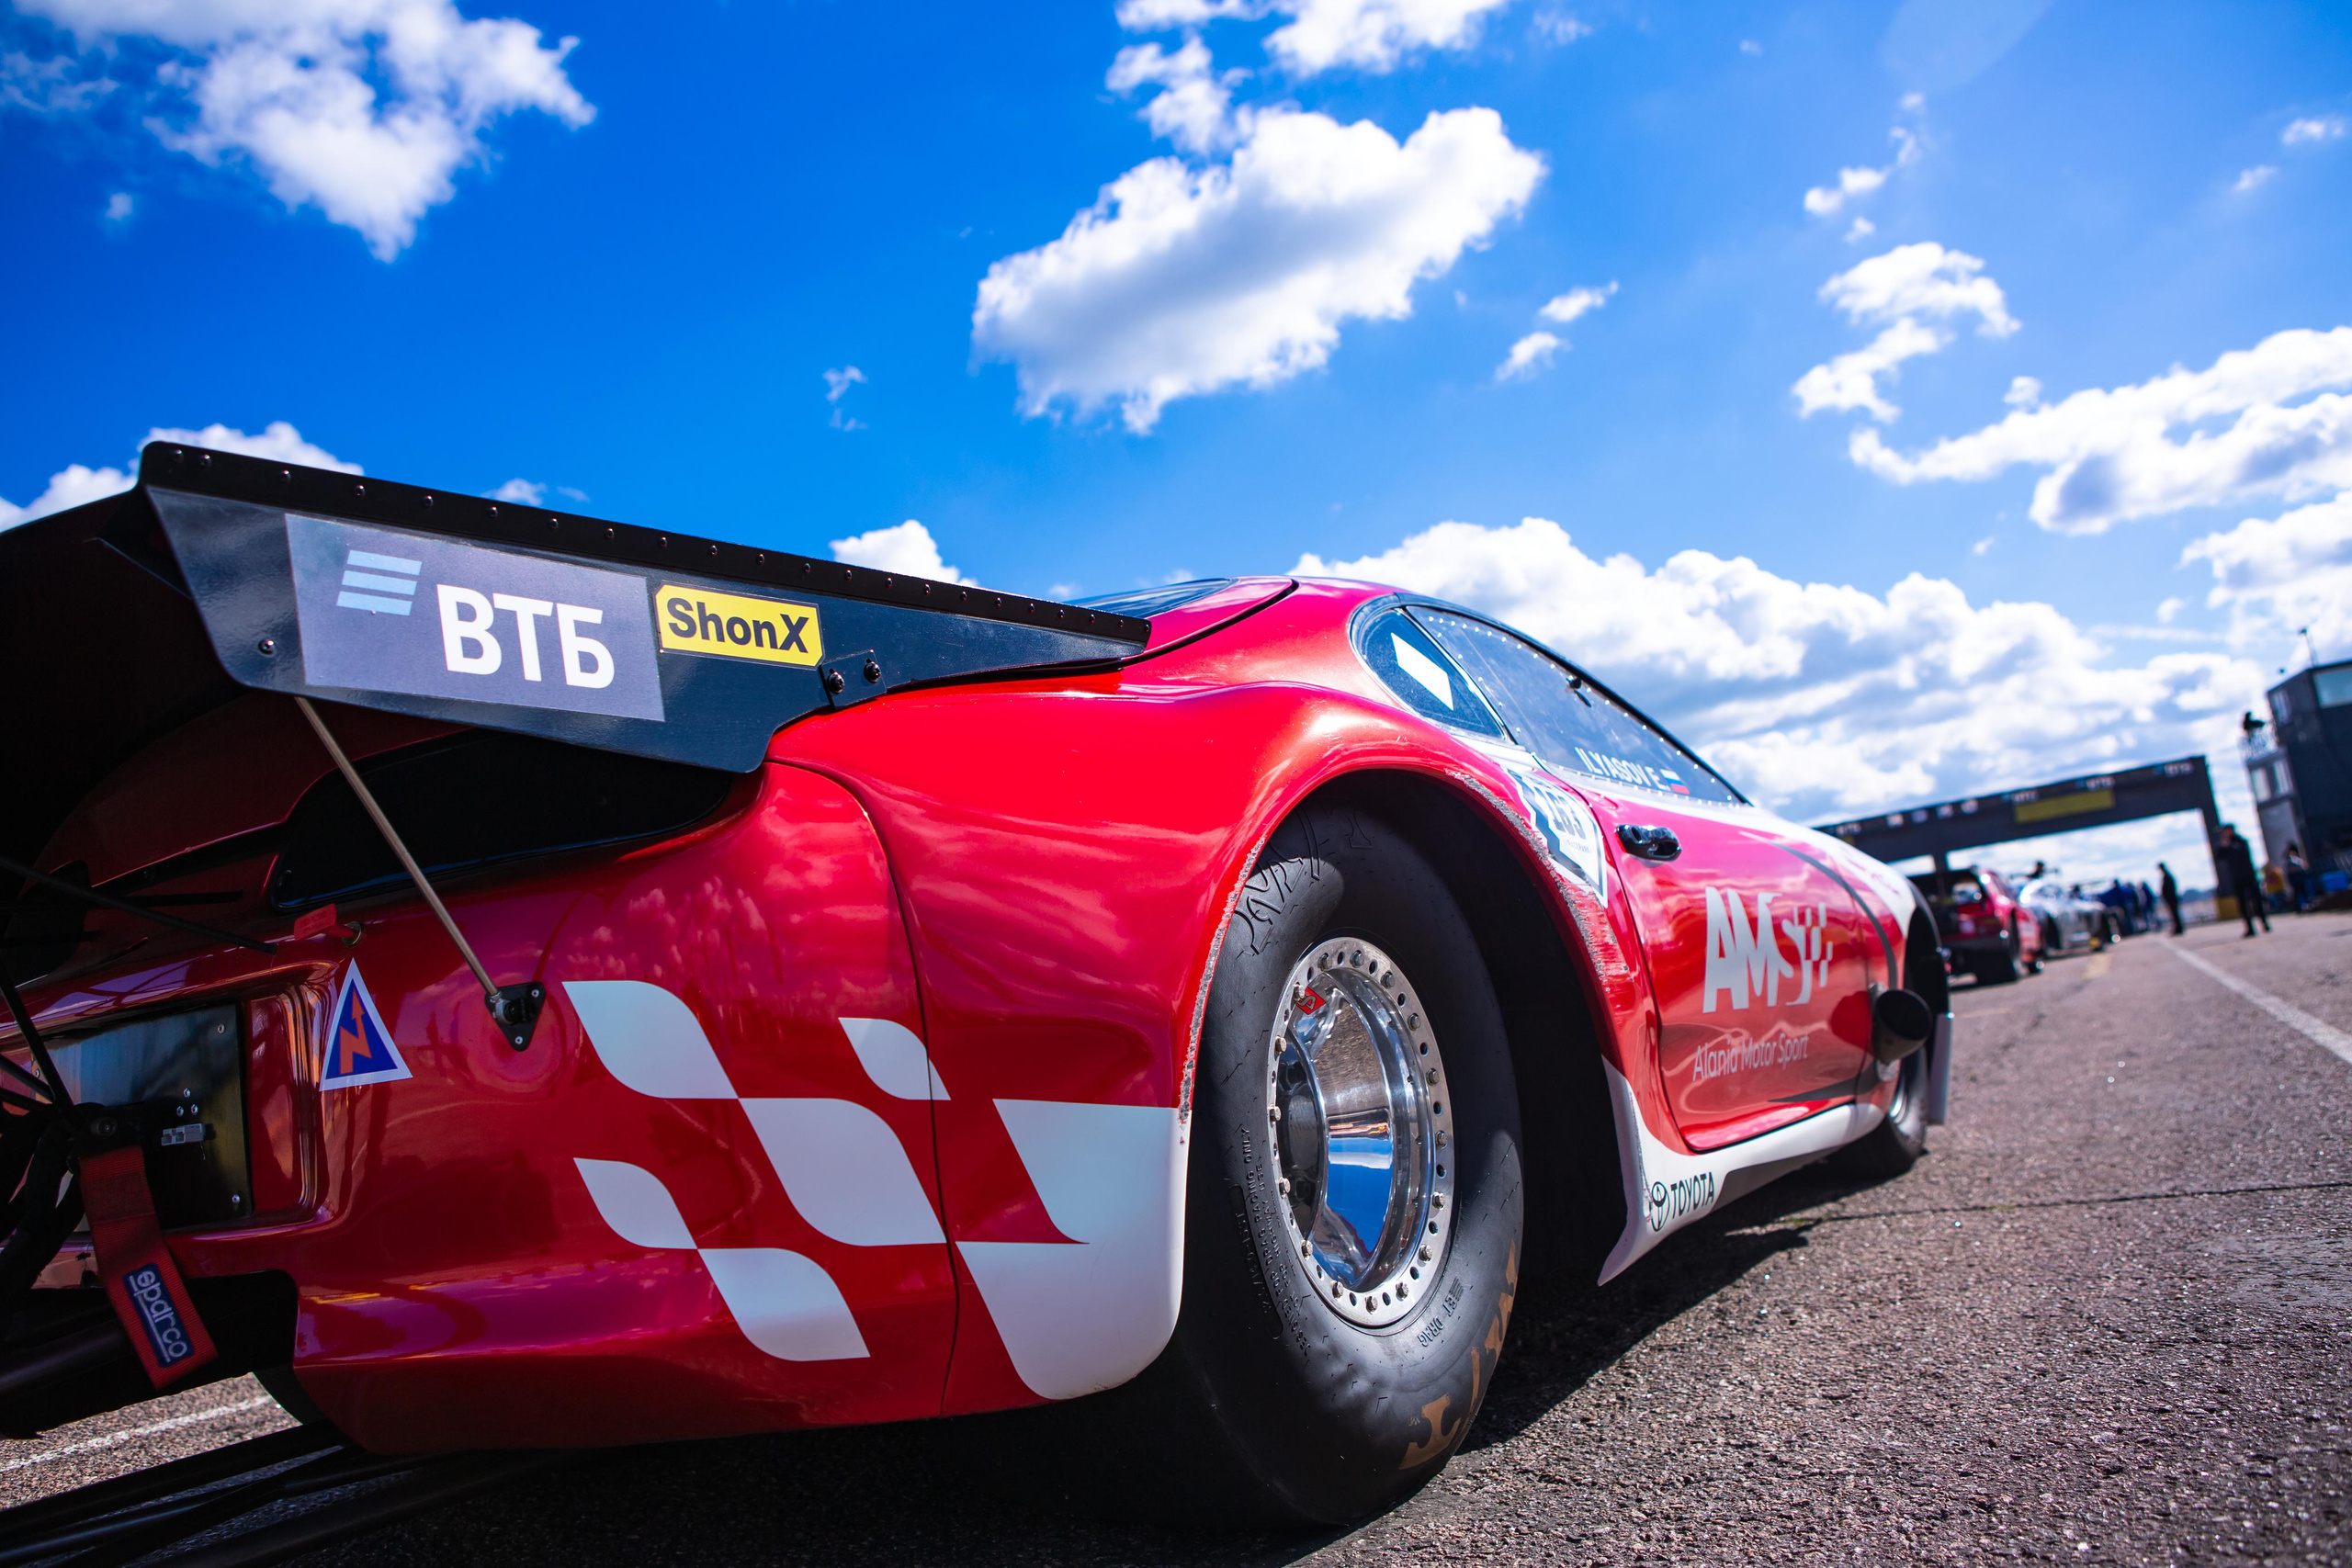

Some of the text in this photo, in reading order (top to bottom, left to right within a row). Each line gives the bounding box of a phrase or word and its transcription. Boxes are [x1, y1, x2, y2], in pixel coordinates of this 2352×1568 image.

[436, 583, 615, 689] ВТБ
[667, 597, 808, 653] ShonX
[1575, 747, 1651, 787] ILYASOV
[1645, 765, 1671, 791] E.
[1692, 1032, 1809, 1082] Alania Motor Sport
[1241, 1127, 1252, 1164] ONLY
[1247, 1170, 1262, 1224] RACING
[1256, 1163, 1266, 1191] USE
[1670, 1171, 1715, 1219] TOYOTA
[1259, 1227, 1273, 1266] DRAG
[1271, 1270, 1284, 1297] FOR
[134, 1270, 187, 1358] sparco
[1417, 1317, 1444, 1348] DRAG
